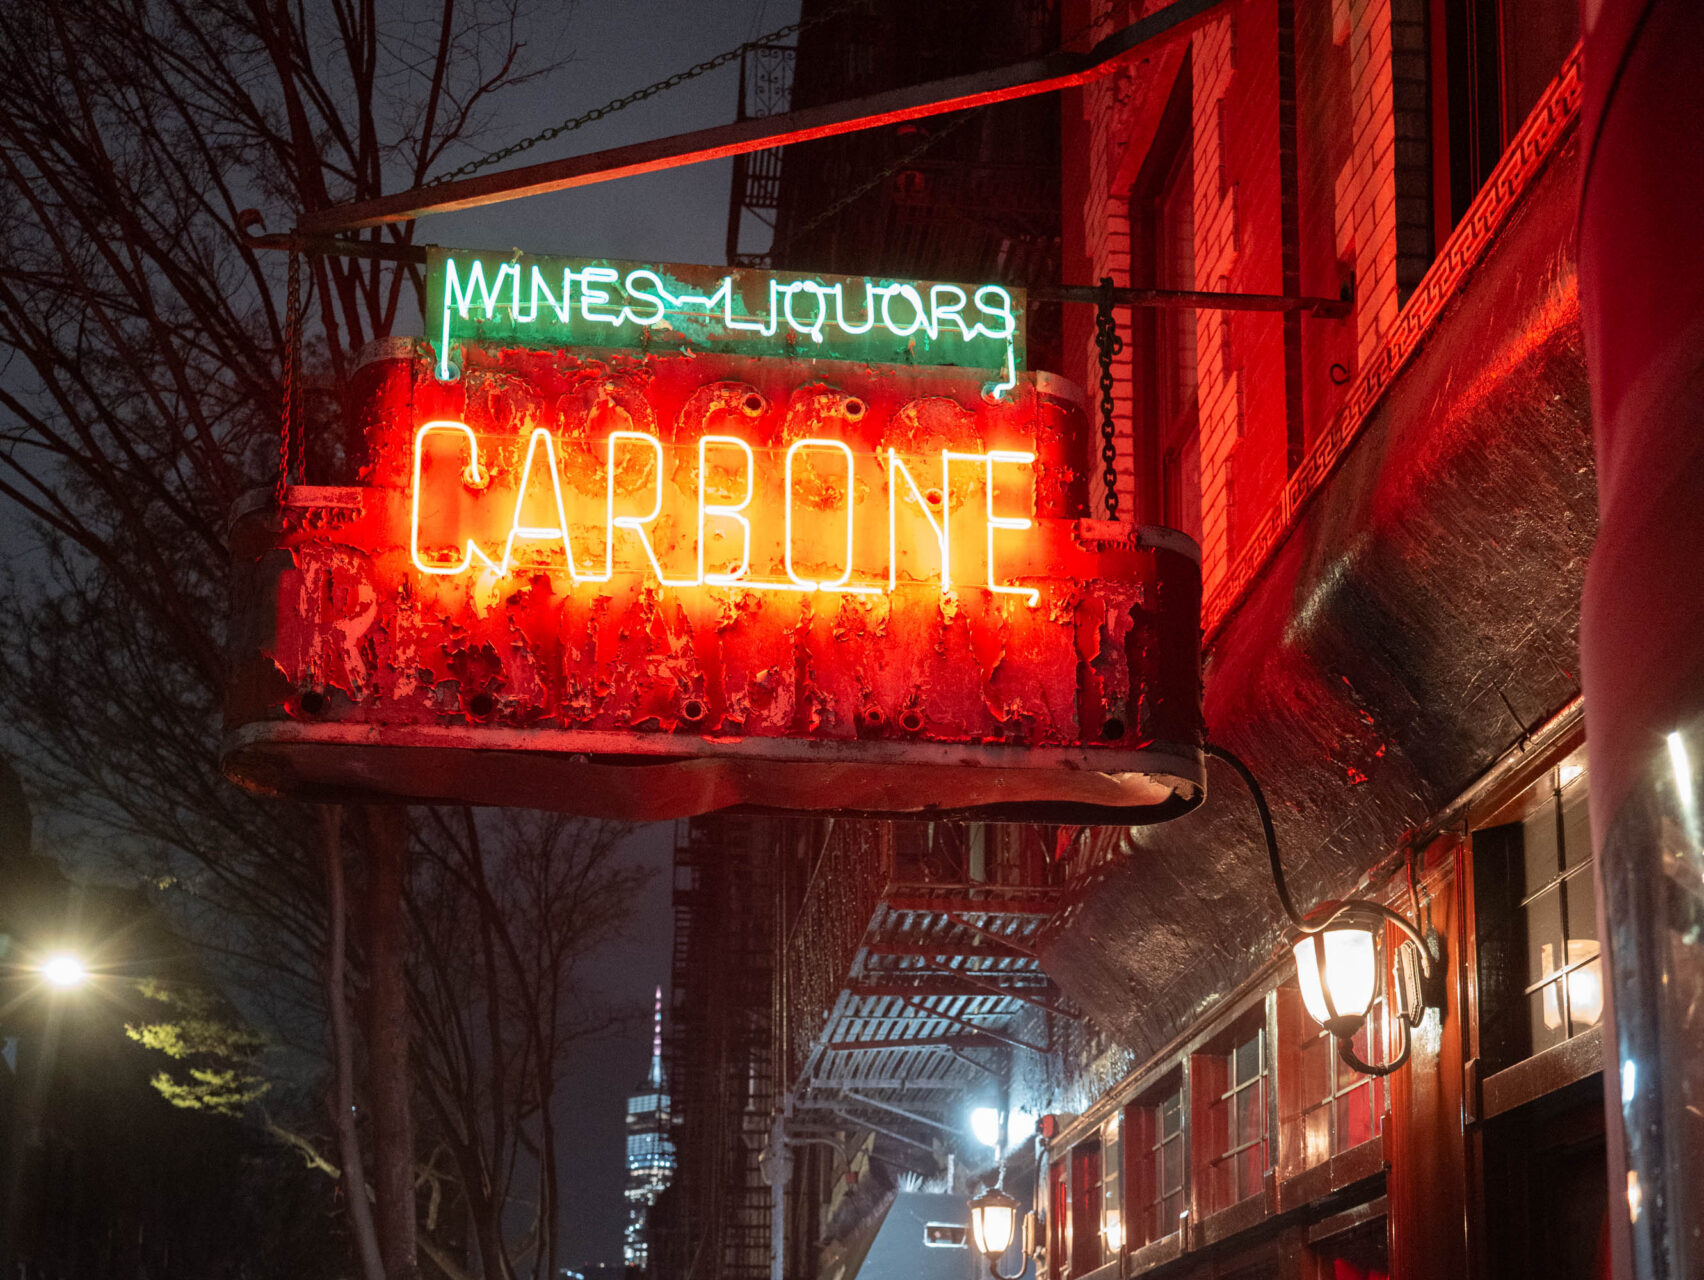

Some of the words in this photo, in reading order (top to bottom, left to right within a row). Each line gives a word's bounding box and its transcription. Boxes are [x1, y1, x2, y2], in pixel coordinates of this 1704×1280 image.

[444, 258, 665, 326] WINES
[724, 277, 1016, 343] LIQUORS
[410, 420, 1036, 600] CARBONE
